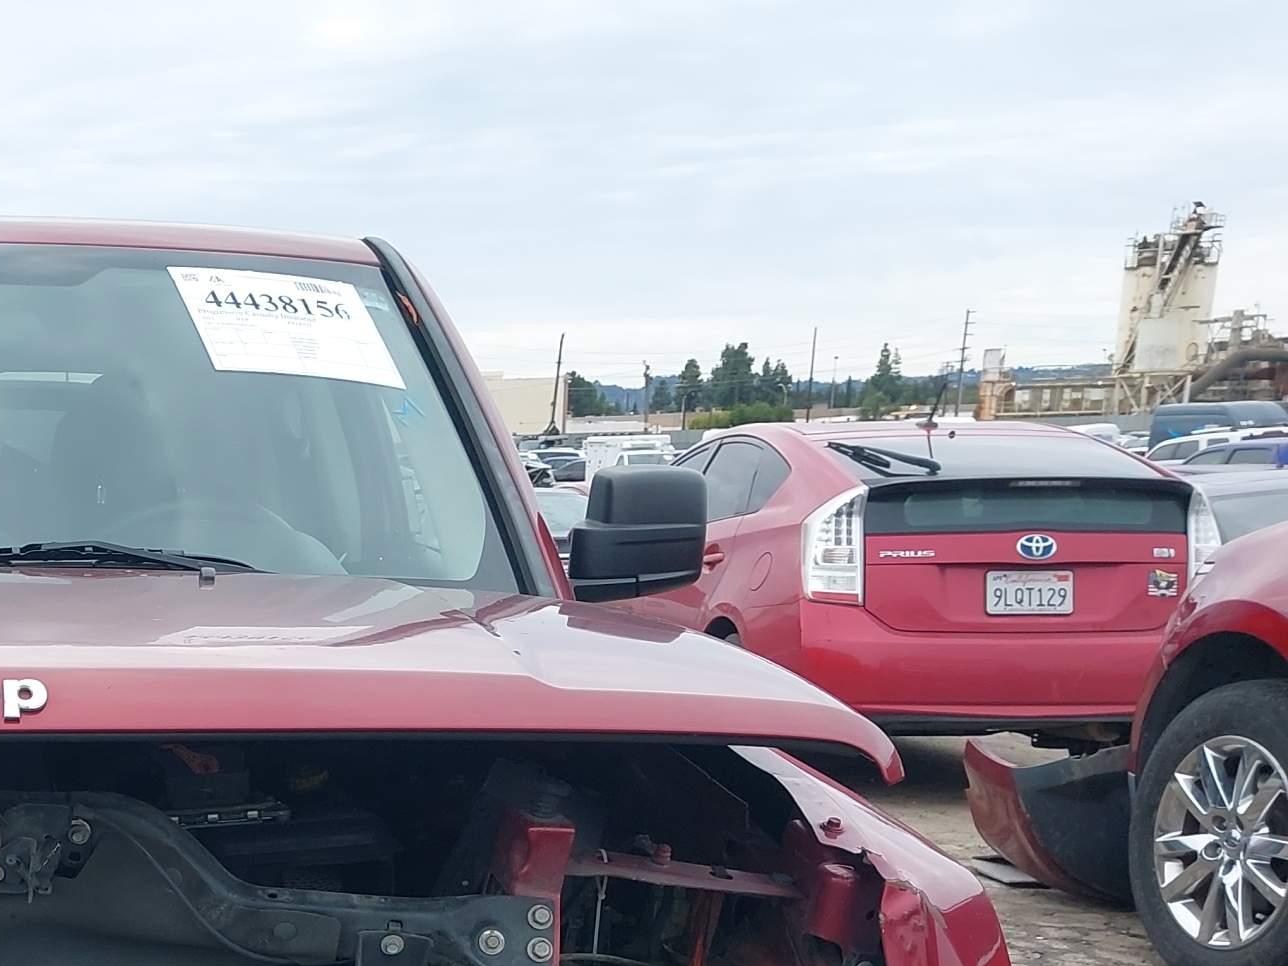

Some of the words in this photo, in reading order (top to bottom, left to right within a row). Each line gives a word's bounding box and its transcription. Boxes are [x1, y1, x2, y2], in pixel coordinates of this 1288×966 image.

[205, 289, 351, 320] 44438156
[879, 550, 935, 558] PRIUS
[993, 587, 1067, 607] 9LQT129
